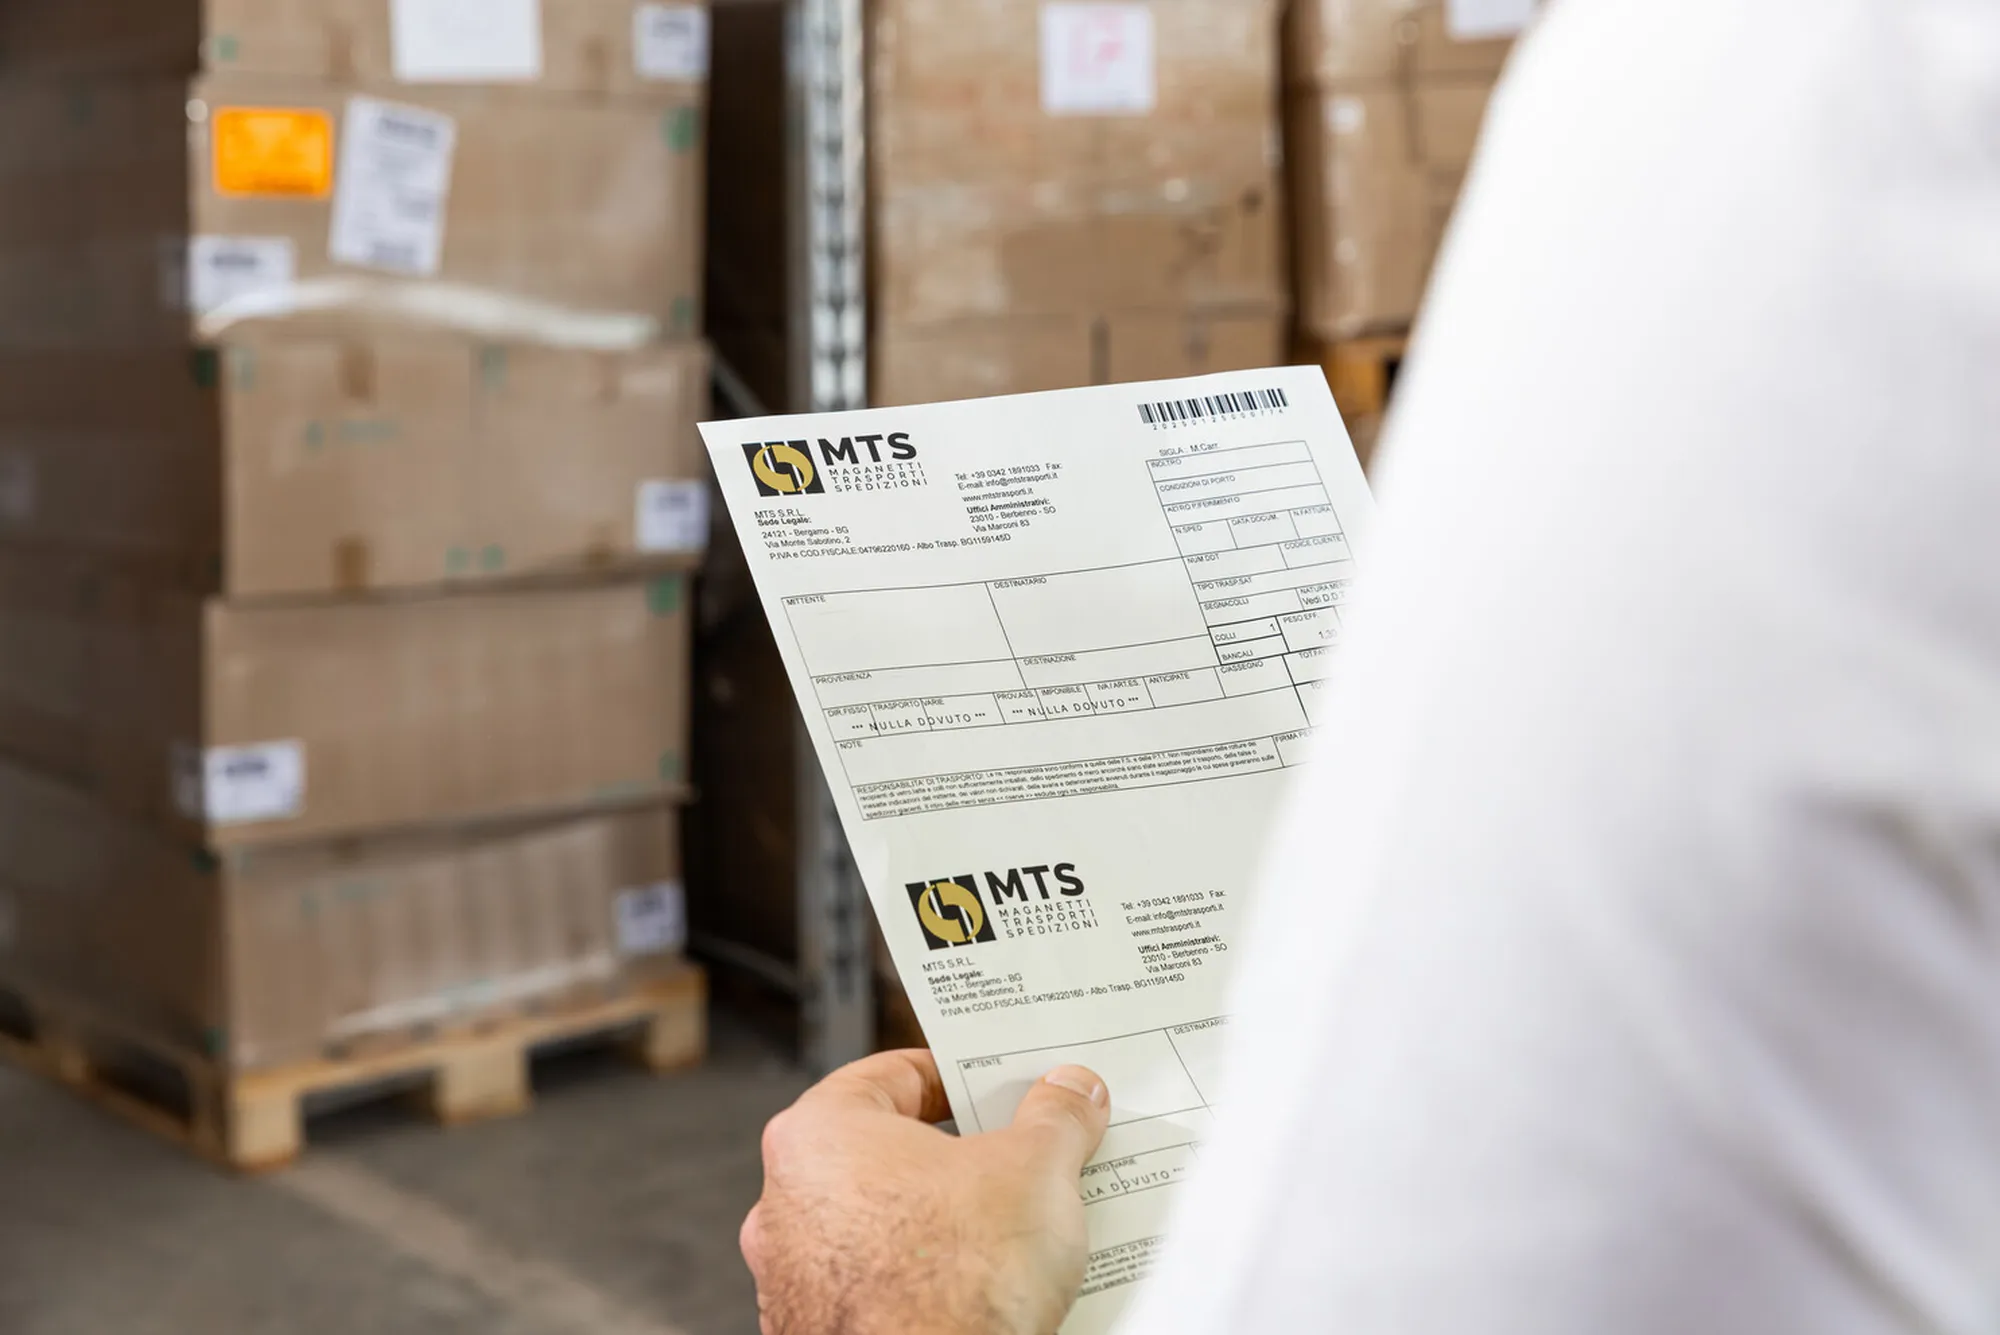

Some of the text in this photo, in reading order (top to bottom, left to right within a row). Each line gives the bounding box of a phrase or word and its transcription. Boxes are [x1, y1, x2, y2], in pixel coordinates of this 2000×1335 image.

[817, 432, 917, 466] MTS
[1159, 447, 1184, 456] SIGLA
[829, 462, 922, 476] MAGANETTI
[1151, 459, 1182, 468] INOLTRO
[831, 470, 925, 484] TRASPORTI
[971, 471, 985, 480] +39
[986, 468, 1005, 478] 0342
[1008, 464, 1040, 475] 1891033
[834, 478, 928, 492] SPEDIZIONI
[985, 472, 1058, 487] info@mtstrasporti.it
[1159, 475, 1236, 492] CONDIZIONI DI PORTO
[962, 488, 1033, 502] www.mtstrasporti.it
[966, 498, 1051, 514] Uffici Amministrativi:
[1293, 505, 1331, 516] N.FATTURA
[754, 510, 776, 520] MTS
[781, 517, 812, 526] Legale:
[970, 506, 1056, 524] 23010 Berbenno SO
[1231, 516, 1250, 526] DATA
[973, 518, 1030, 532] Via Marconi 83
[762, 526, 849, 539] 24121 Bergamo BG
[765, 541, 779, 549] Via
[780, 539, 804, 547] Monte
[770, 550, 792, 560] P.IVA
[917, 541, 934, 550] Albo
[935, 540, 957, 549] Trasp.
[960, 533, 1011, 546] BG1159145D
[1284, 535, 1342, 550] CODICE CLIENTE
[993, 577, 1047, 589] DESTINATARIO
[1197, 581, 1215, 591] TIPO
[1300, 584, 1328, 594] NATURA
[786, 595, 826, 606] MITTENTE
[1203, 598, 1249, 611] SEGNACOLLI
[1302, 596, 1322, 606] Vedi
[1282, 615, 1303, 624] PESO
[1214, 623, 1276, 642] COLLI 1
[1023, 654, 1076, 666] DESTINAZIONE
[1221, 649, 1253, 661] BANCALI
[815, 671, 872, 684] PROVENIENZA
[1149, 673, 1190, 684] ANTICIPATE
[1041, 685, 1082, 696] IMPONIBILE
[873, 700, 920, 712] TRASPORTO
[921, 698, 944, 707] VARIE
[1028, 698, 1125, 717] NULLA DOVUTO
[869, 713, 972, 732] NULLA DOVUTO
[840, 740, 862, 750] NOTE
[1274, 733, 1298, 743] FIRMA
[926, 777, 935, 786] DI
[984, 862, 1084, 905] MTS
[1137, 899, 1151, 909] +39
[1152, 896, 1171, 907] 0342
[1172, 892, 1204, 904] 1891033
[998, 899, 1091, 918] MAGANETTI
[1126, 903, 1224, 924] E-mail: info@mtstrasporti.it
[1002, 909, 1095, 928] TRASPORTI
[1006, 919, 1099, 938] SPEDIZIONI
[1131, 920, 1201, 937] www.mtstrasporti.it
[1138, 934, 1221, 954] Uffici Amministrativi:
[1142, 942, 1228, 964] 23010 Berbenno SO
[922, 961, 945, 972] MTS
[1145, 957, 1203, 973] Via Marconi 83
[928, 975, 951, 985] Sede
[932, 972, 1022, 995] 24121 Bergamo BG
[1090, 986, 1108, 996] Albo
[1108, 982, 1133, 993] Trasp.
[1134, 973, 1185, 989] BG1159145D
[936, 996, 950, 1005] Via
[951, 992, 978, 1002] Monte
[1018, 983, 1024, 993] 2
[962, 1057, 1003, 1070] MITTENTE
[1080, 1169, 1170, 1201] LLA DOVUTO
